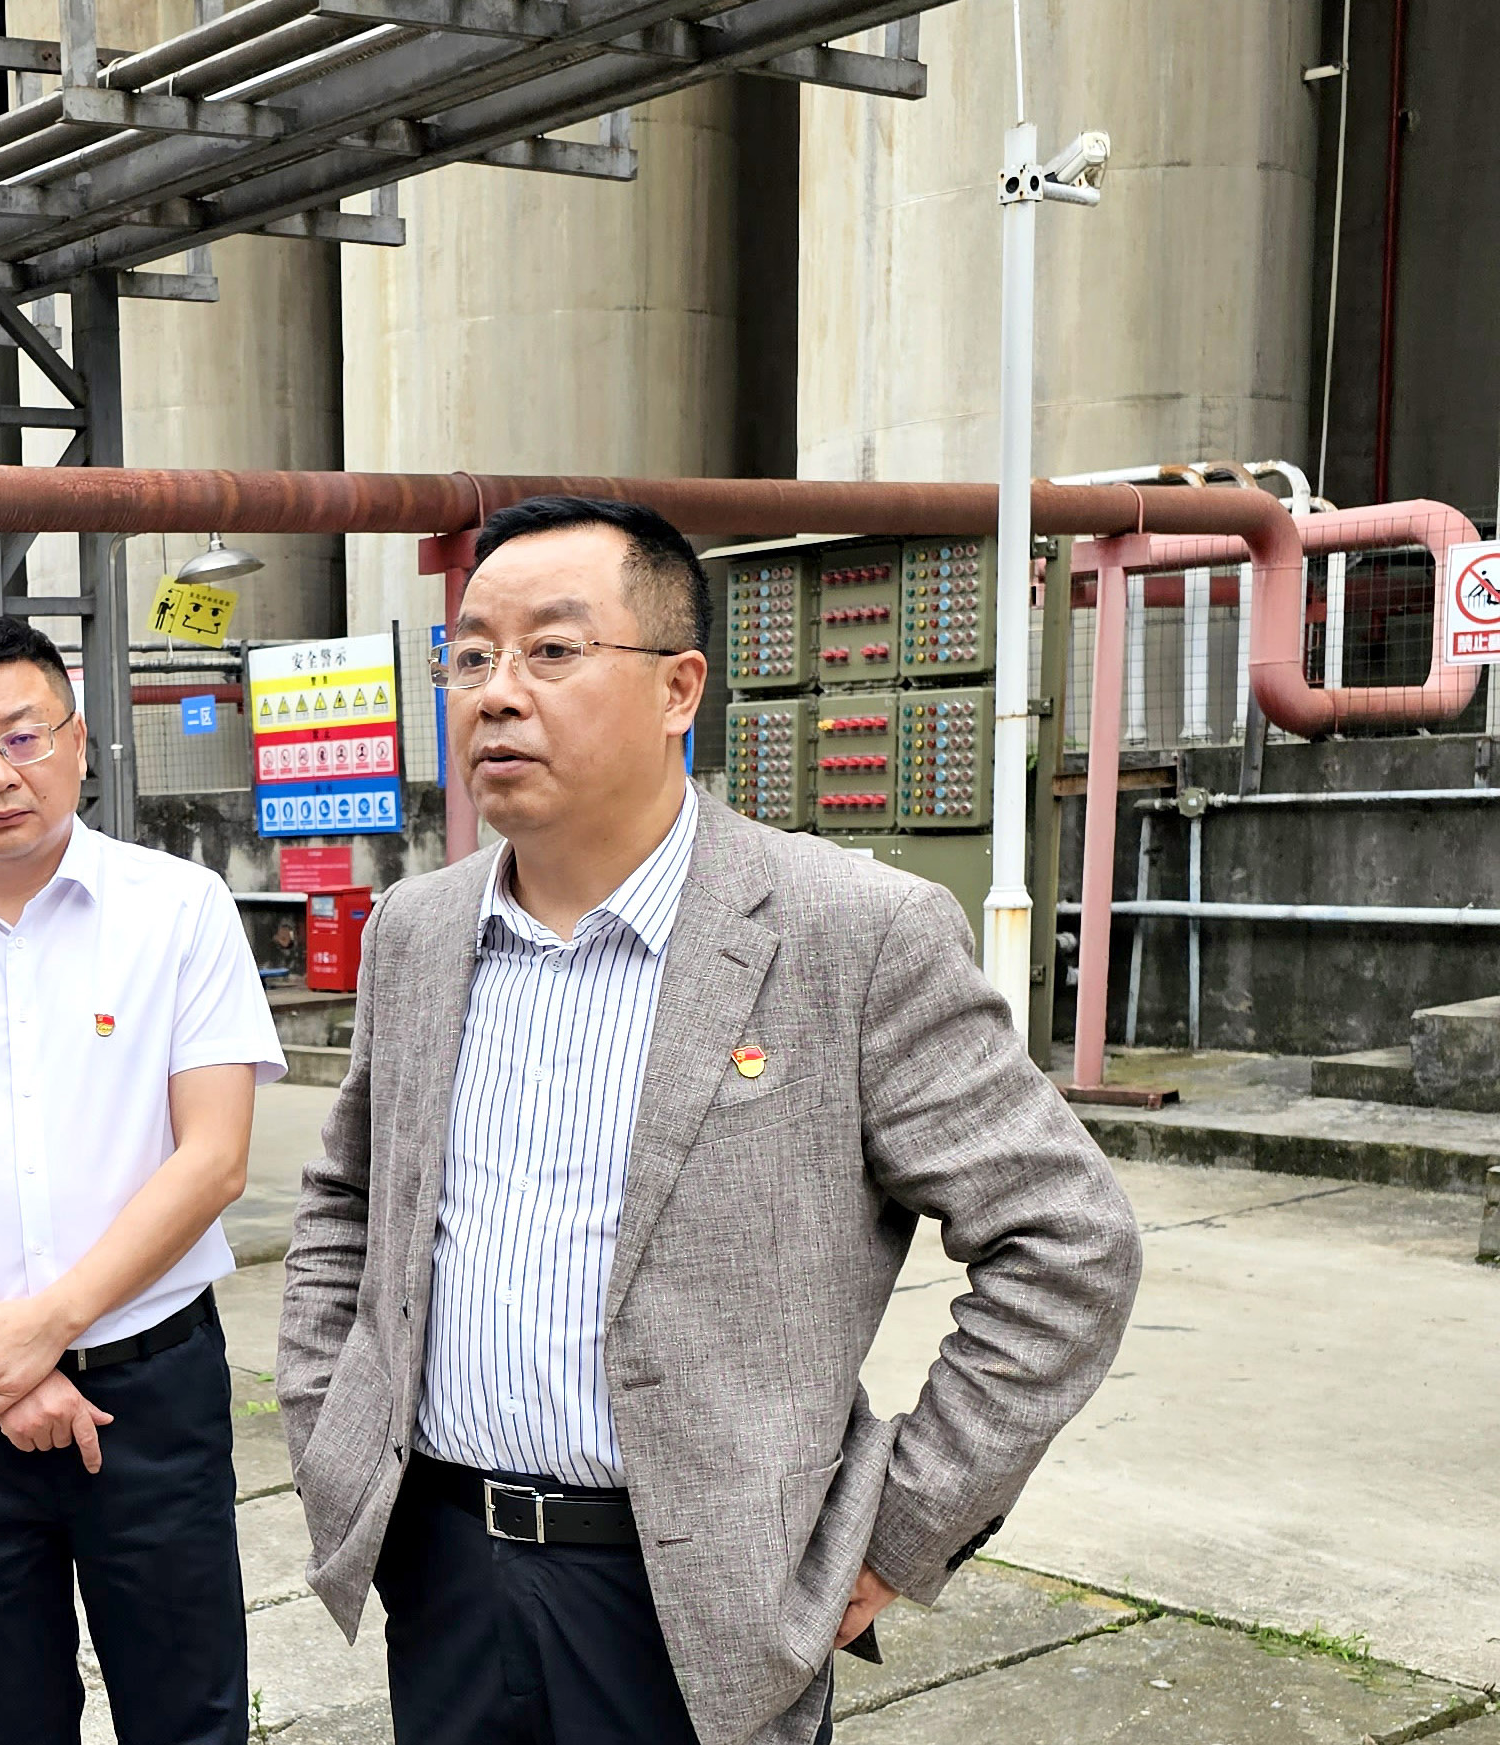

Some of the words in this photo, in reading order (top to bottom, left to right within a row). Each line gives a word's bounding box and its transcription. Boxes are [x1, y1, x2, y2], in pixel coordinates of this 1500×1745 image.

[291, 646, 347, 672] 安全警示
[187, 706, 213, 726] 二区
